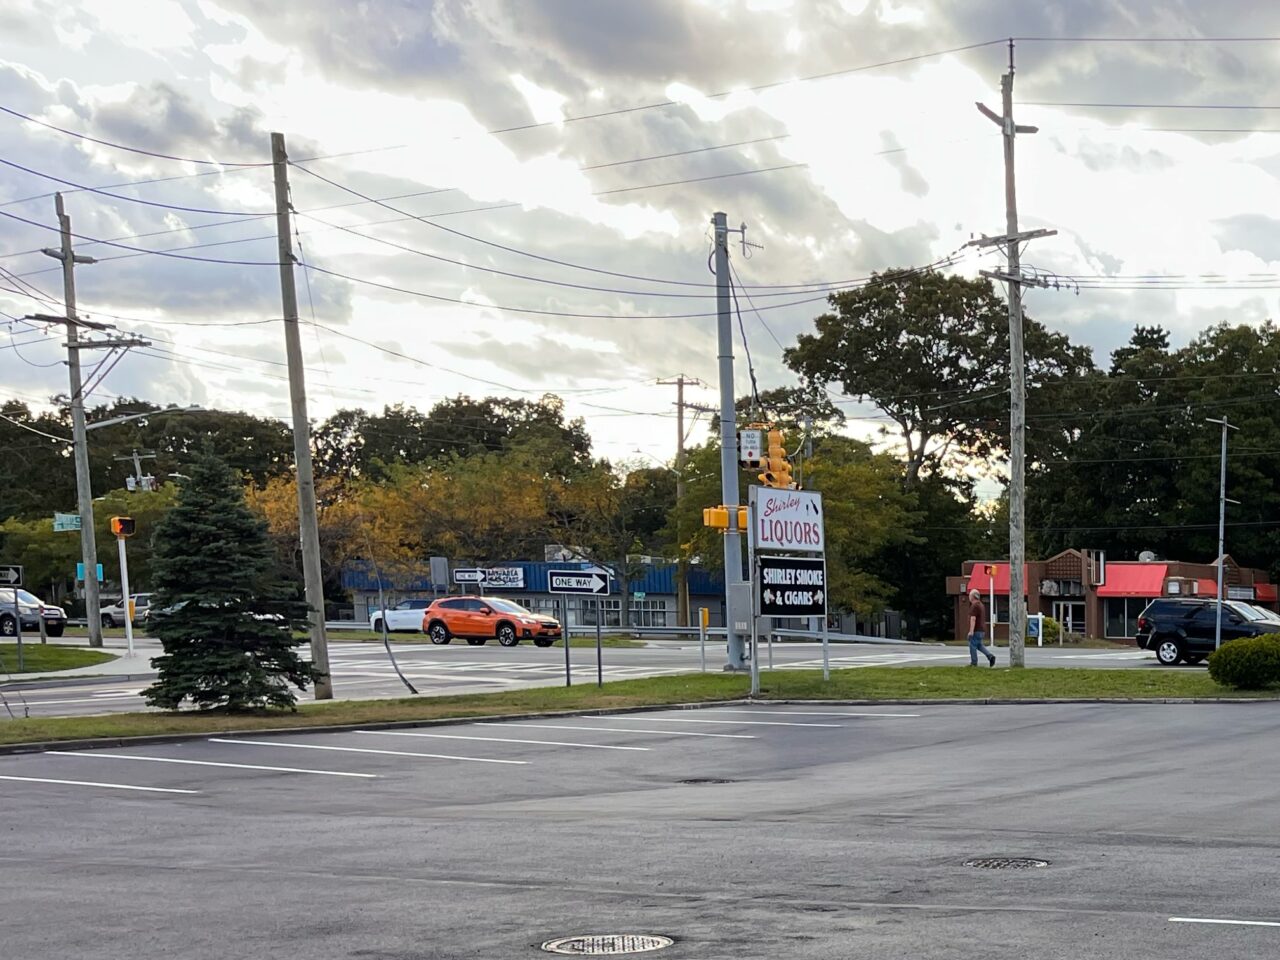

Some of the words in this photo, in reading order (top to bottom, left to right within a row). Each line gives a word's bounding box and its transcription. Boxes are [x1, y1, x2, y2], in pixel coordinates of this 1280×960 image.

[764, 493, 801, 517] Shirley
[761, 519, 820, 546] LIQUORS
[555, 578, 573, 587] ONE
[575, 578, 592, 587] WAY
[763, 568, 795, 585] SHIRLEY
[796, 569, 823, 586] SMOKE
[776, 590, 783, 605] &
[784, 591, 813, 605] CIGARS
